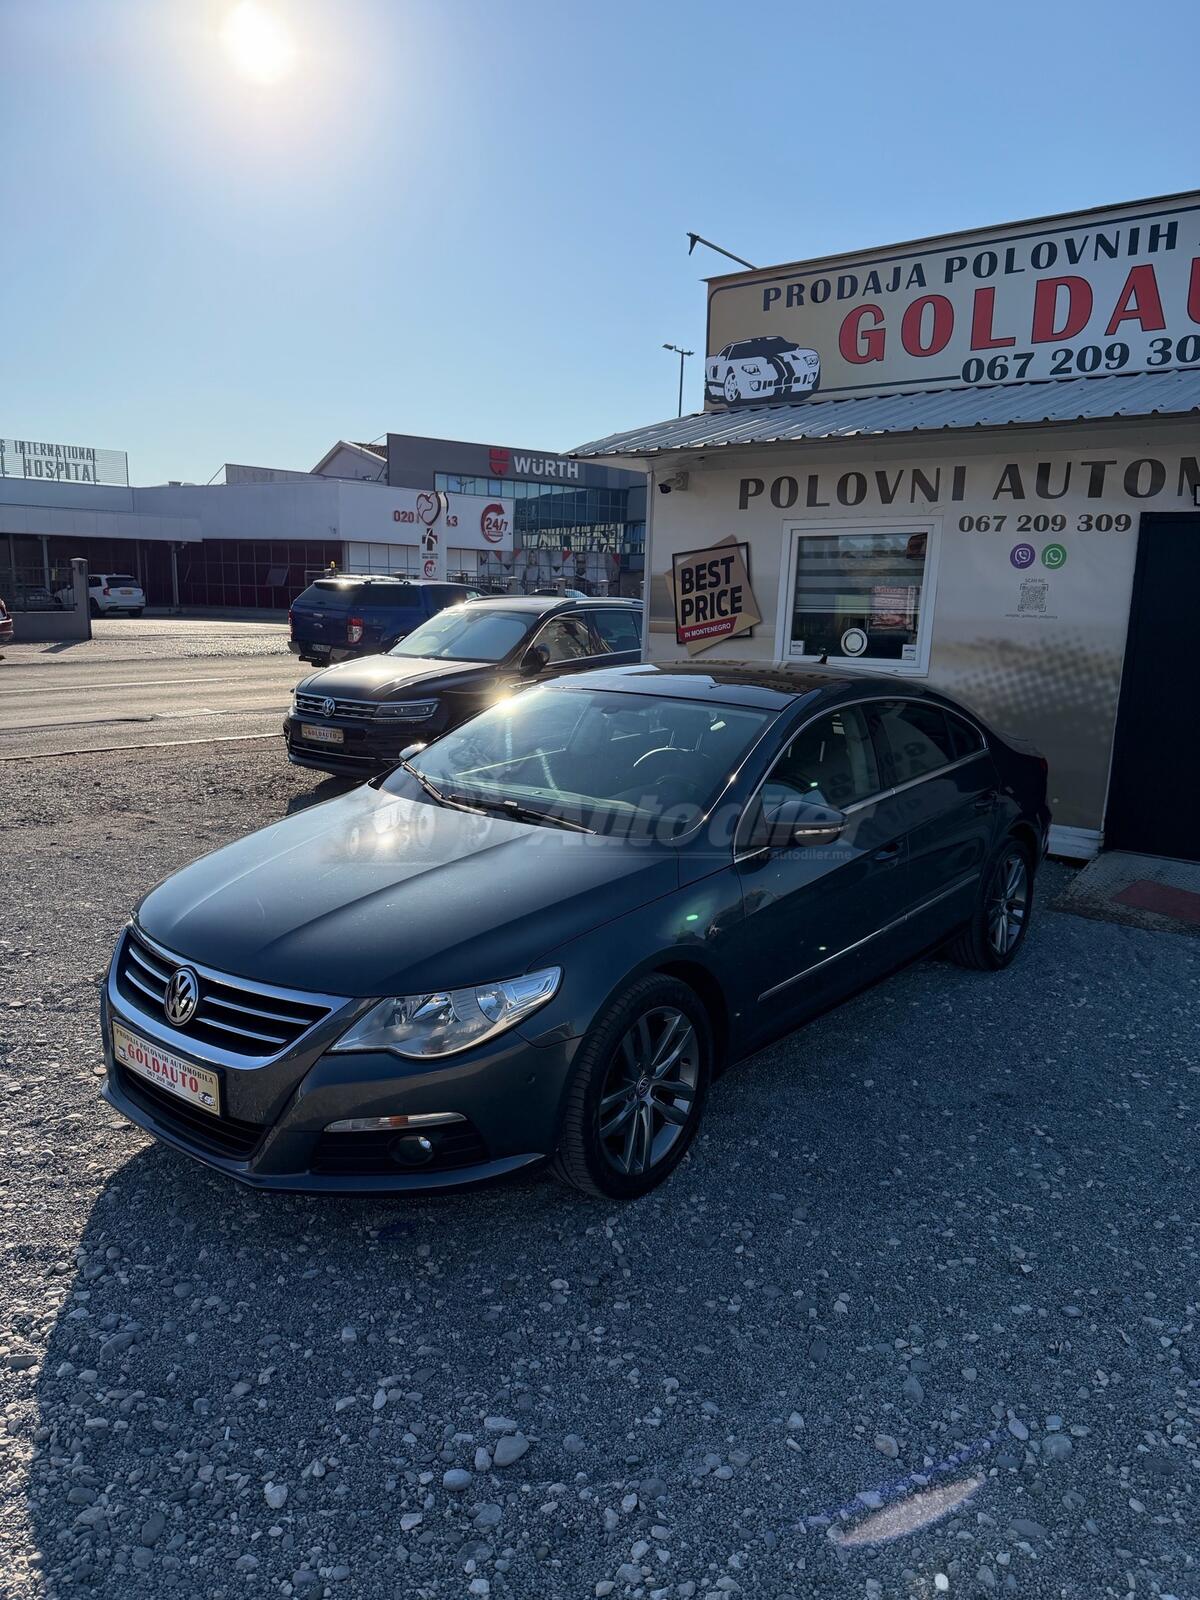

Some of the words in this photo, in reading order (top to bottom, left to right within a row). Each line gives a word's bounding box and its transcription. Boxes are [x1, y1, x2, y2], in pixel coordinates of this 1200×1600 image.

[763, 262, 927, 312] PRODAJA
[944, 220, 1179, 285] POLOVNIH
[838, 257, 1200, 365] GOLDA
[961, 351, 1033, 384] 067
[1050, 342, 1131, 376] 209
[15, 440, 99, 461] INTERNATIONAL
[24, 459, 101, 482] HOSPITAL
[738, 465, 967, 510] POLOVNI
[485, 517, 508, 531] 24/7
[958, 515, 1008, 533] 067
[1016, 514, 1067, 532] 209
[1076, 513, 1132, 532] 309
[681, 555, 735, 596] BEST
[681, 586, 742, 626] PRICE
[691, 622, 731, 637] MONTENEGRO
[127, 1043, 199, 1093] GOLDAUTO
[170, 1059, 214, 1084] AUTOMOBILA
